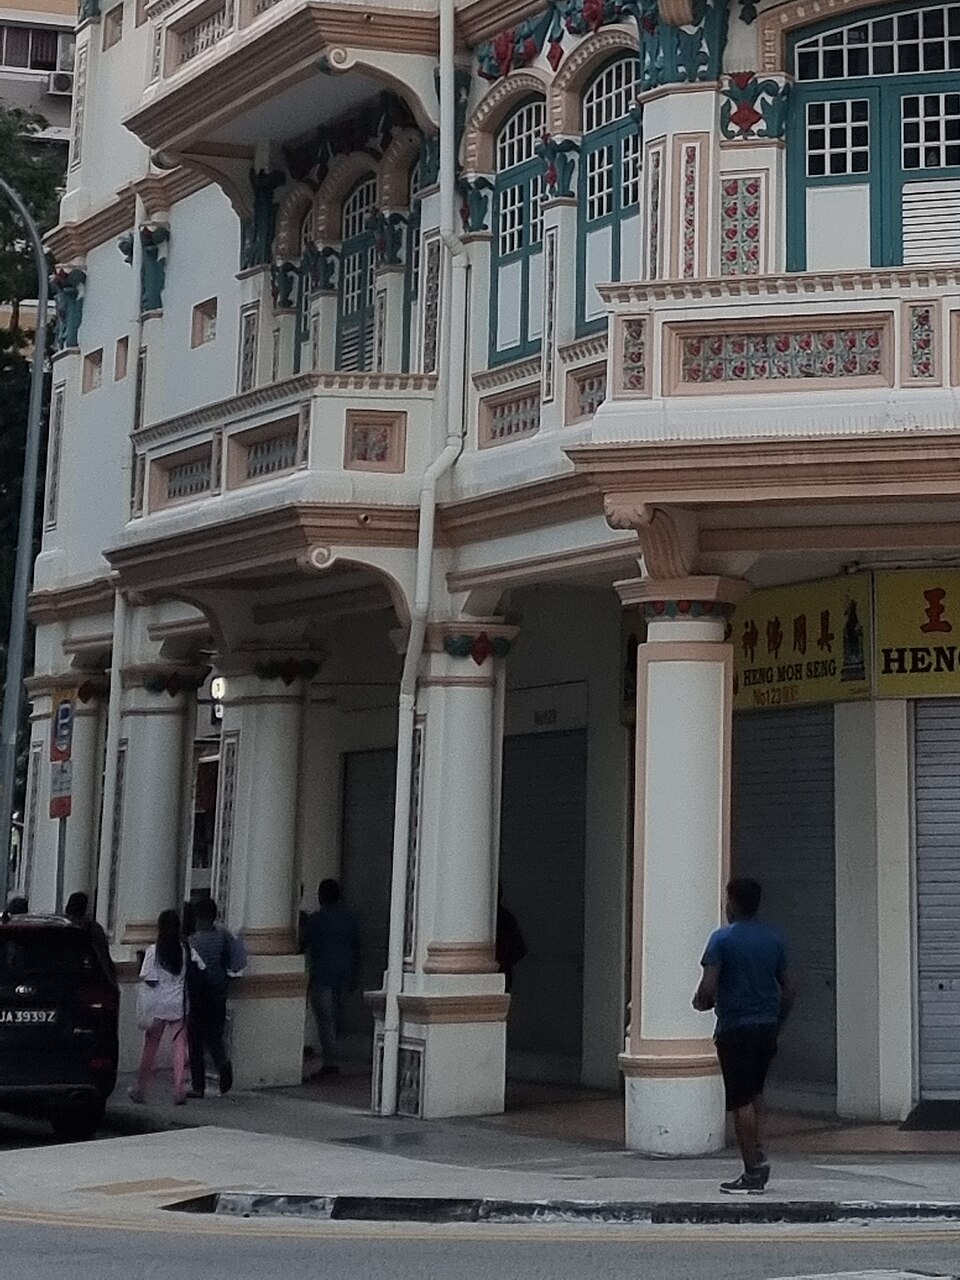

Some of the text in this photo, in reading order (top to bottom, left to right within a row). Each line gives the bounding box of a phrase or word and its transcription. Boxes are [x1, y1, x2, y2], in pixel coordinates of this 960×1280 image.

[743, 659, 837, 686] HENG MOH SENG
